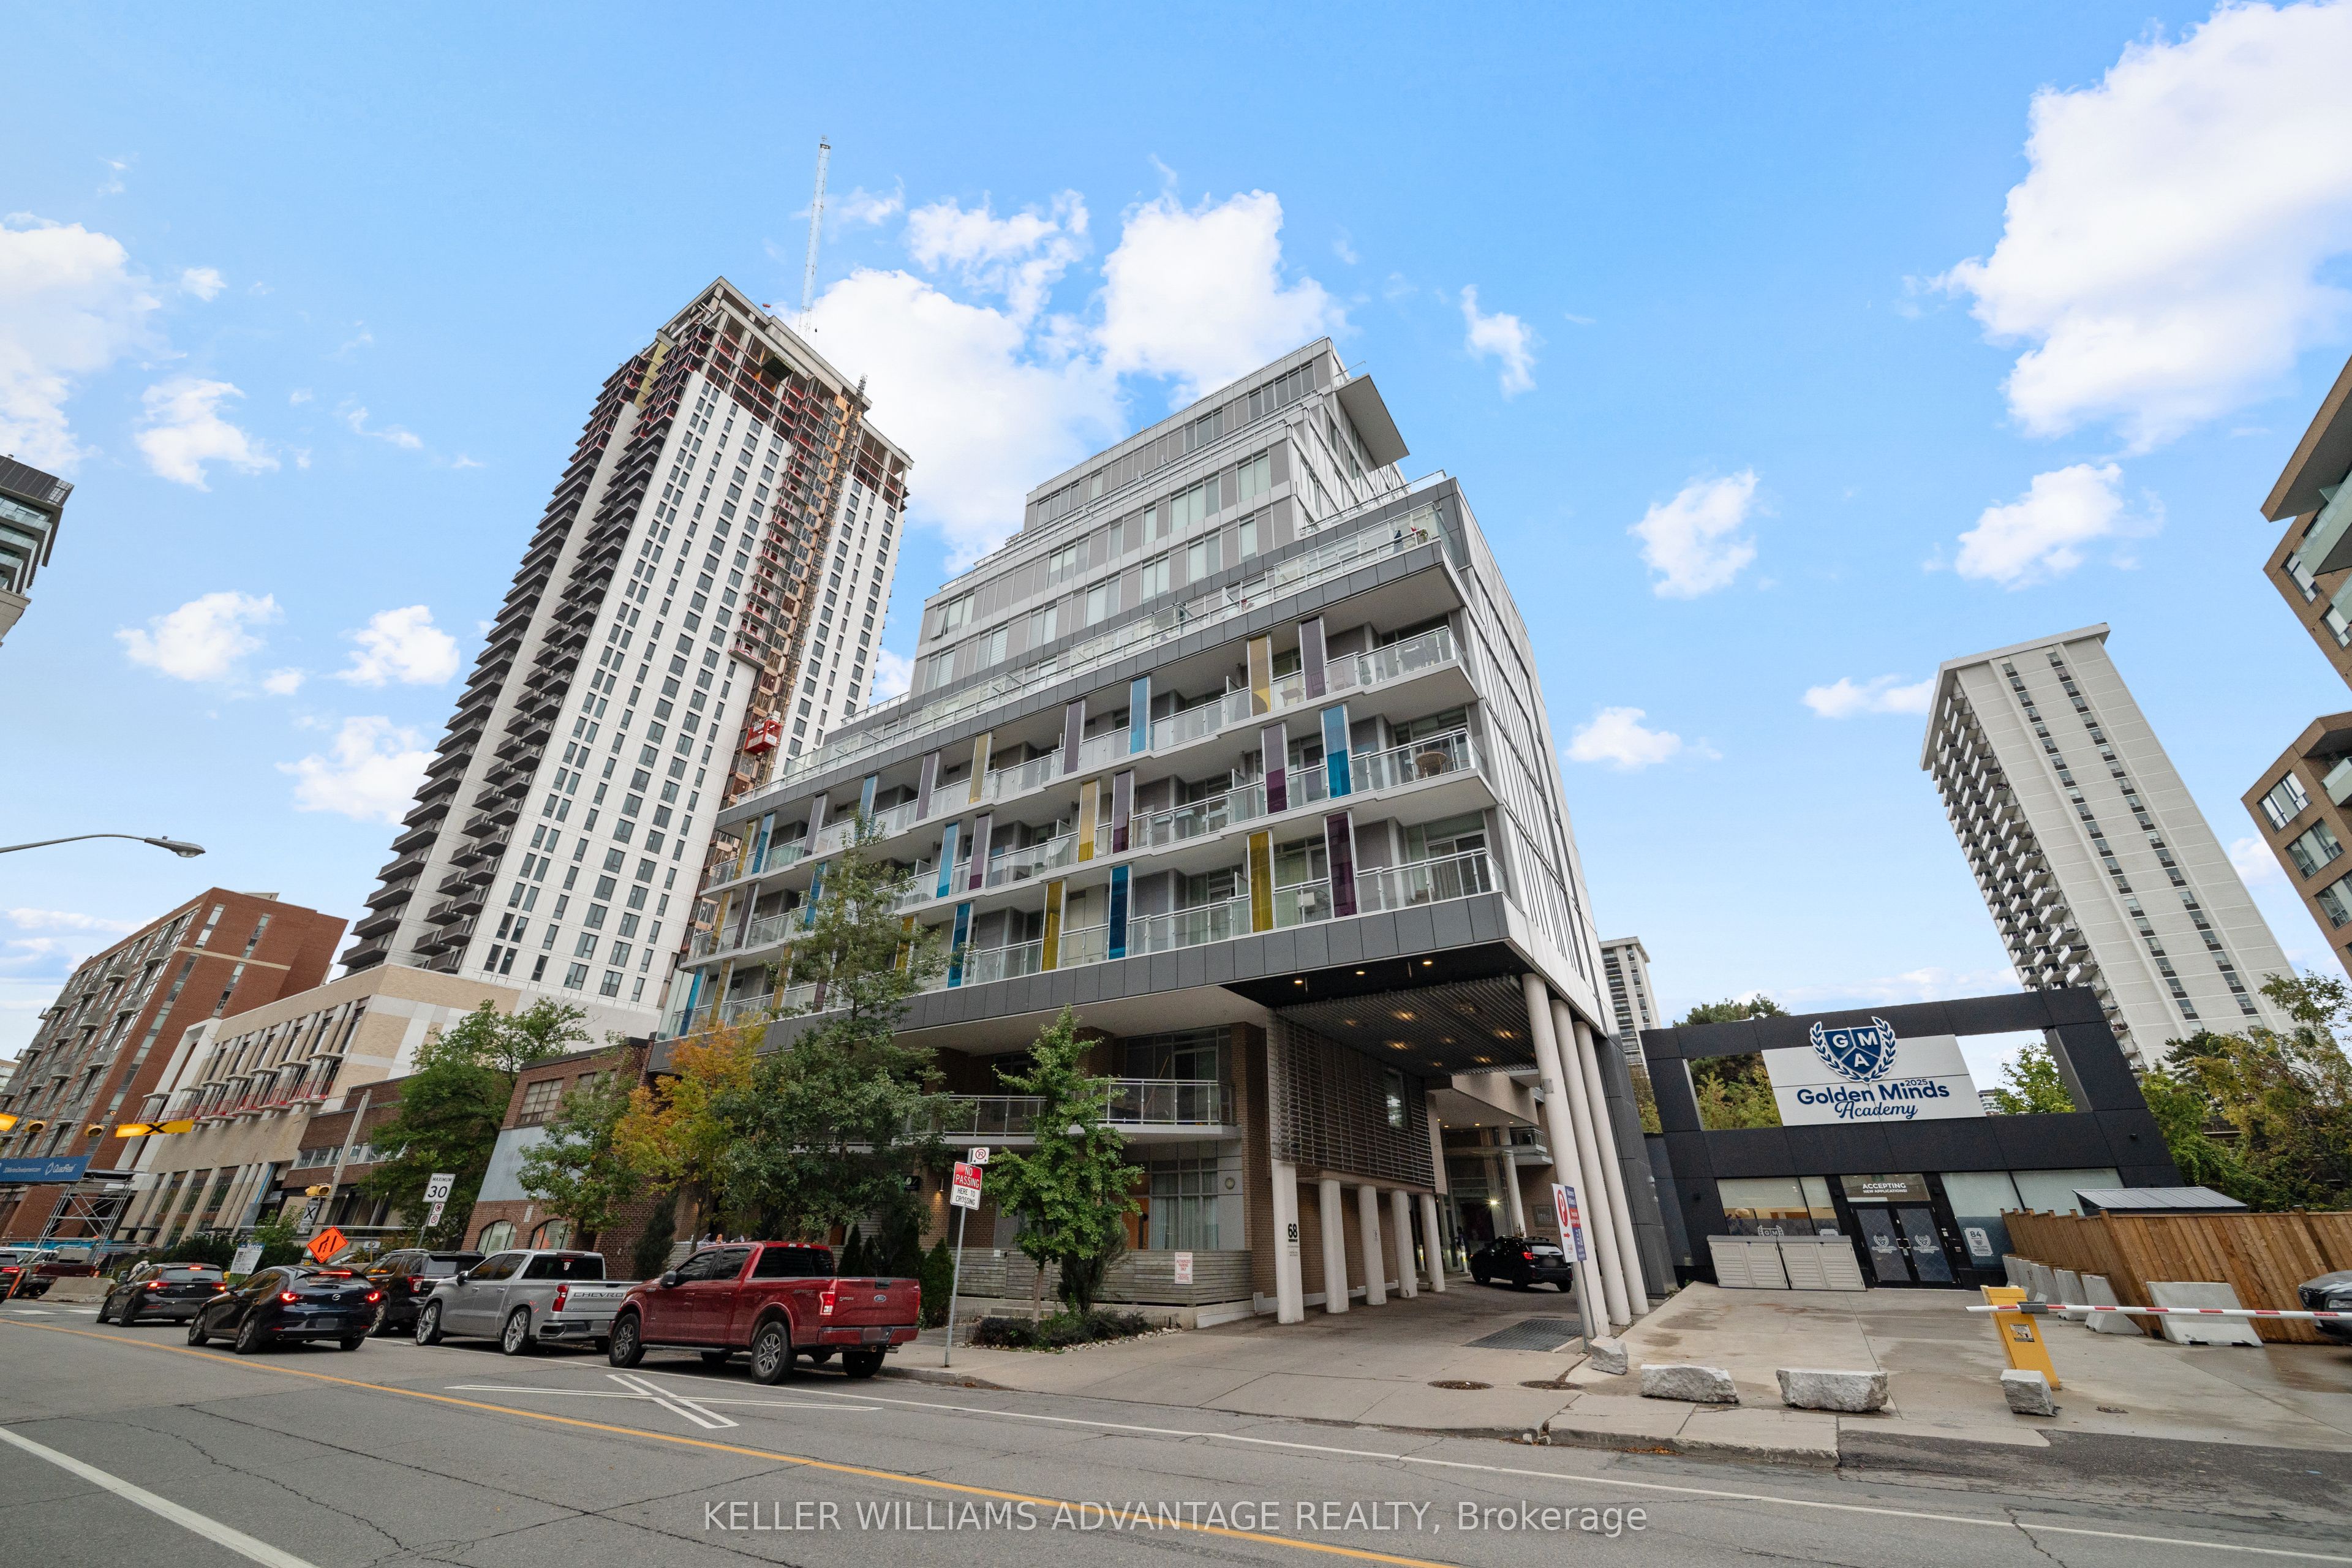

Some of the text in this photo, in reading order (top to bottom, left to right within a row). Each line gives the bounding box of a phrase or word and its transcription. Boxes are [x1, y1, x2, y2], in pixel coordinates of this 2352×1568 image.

[1833, 1031, 1878, 1048] G M
[1854, 1053, 1870, 1068] A
[1797, 1080, 1950, 1105] Golden Minds
[1834, 1101, 1918, 1120] Academy
[53, 1163, 77, 1173] QuadReal
[965, 1166, 973, 1176] NO
[956, 1174, 979, 1188] PASSING
[428, 1185, 448, 1198] 30
[956, 1195, 976, 1205] CROSSING
[1288, 1223, 1297, 1238] 68
